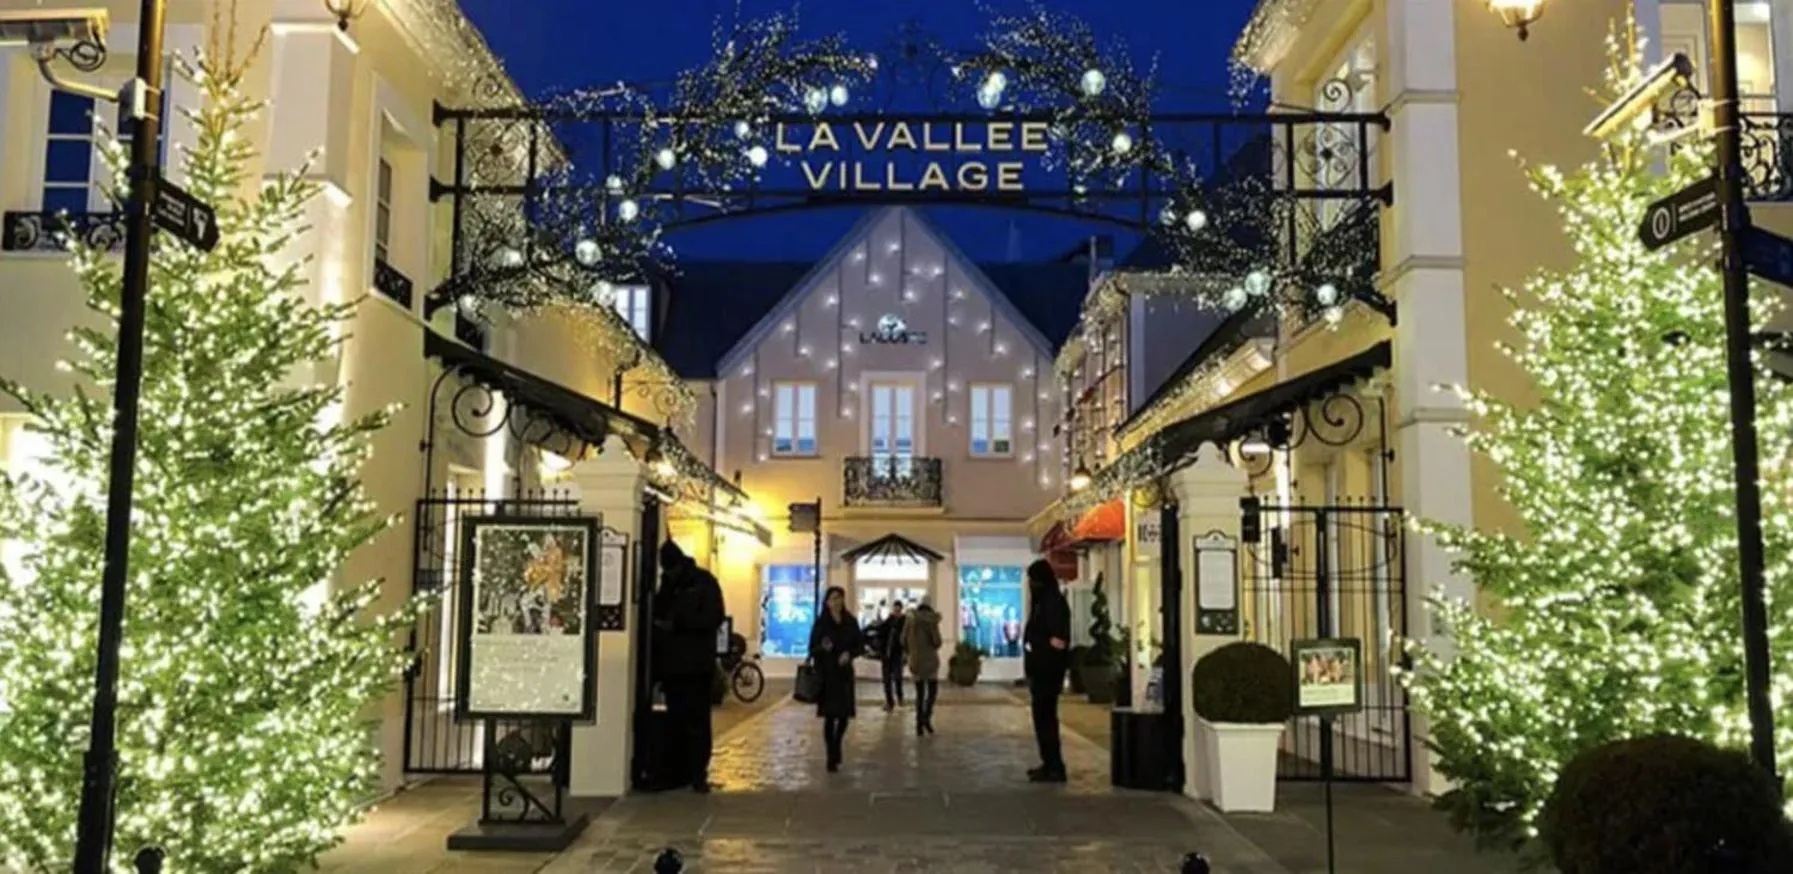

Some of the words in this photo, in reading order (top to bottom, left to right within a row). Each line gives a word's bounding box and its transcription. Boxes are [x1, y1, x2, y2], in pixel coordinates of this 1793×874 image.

[775, 121, 840, 151] LA
[853, 121, 1049, 151] VALLEE
[801, 161, 1024, 191] VILLAGE
